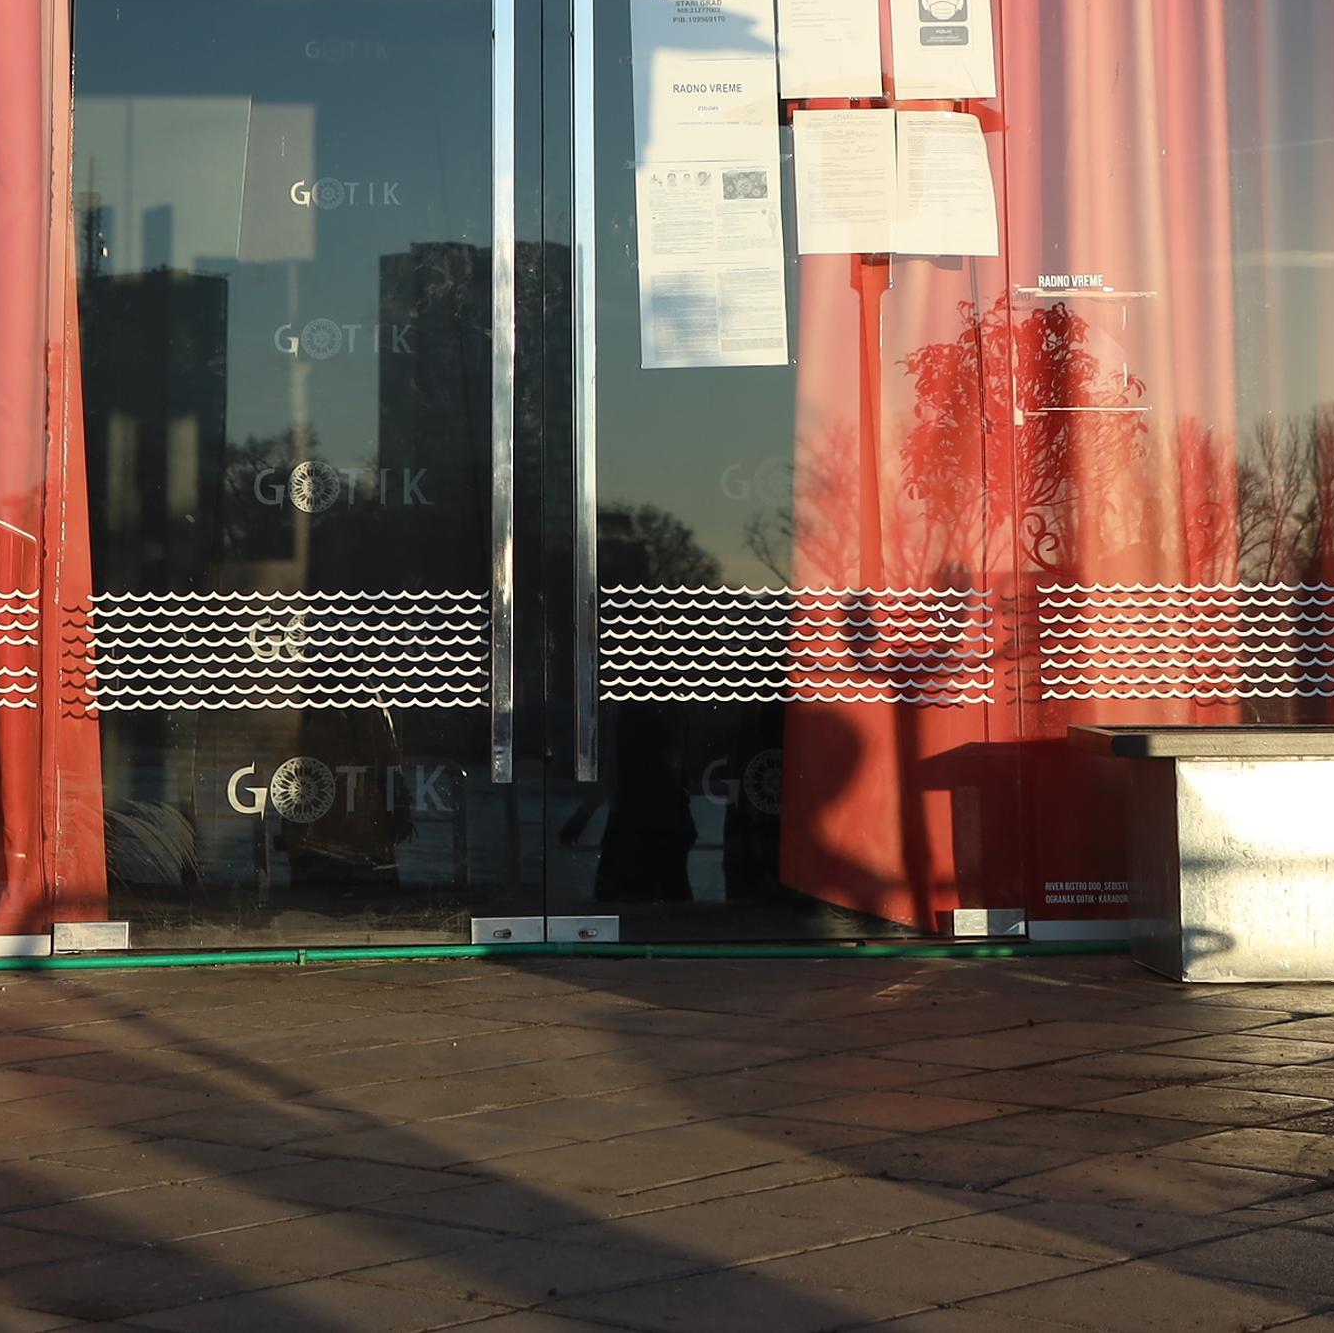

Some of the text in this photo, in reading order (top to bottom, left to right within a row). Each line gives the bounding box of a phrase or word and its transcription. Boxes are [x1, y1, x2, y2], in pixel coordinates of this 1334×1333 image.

[699, 0, 723, 7] GRAD
[672, 83, 743, 94] RADNO VREME
[289, 176, 402, 211] GOTIK
[1038, 274, 1104, 288] RADNO VREME
[273, 318, 415, 360] GOTIK
[252, 460, 436, 514] GOTIK
[226, 755, 460, 824] GOTIK
